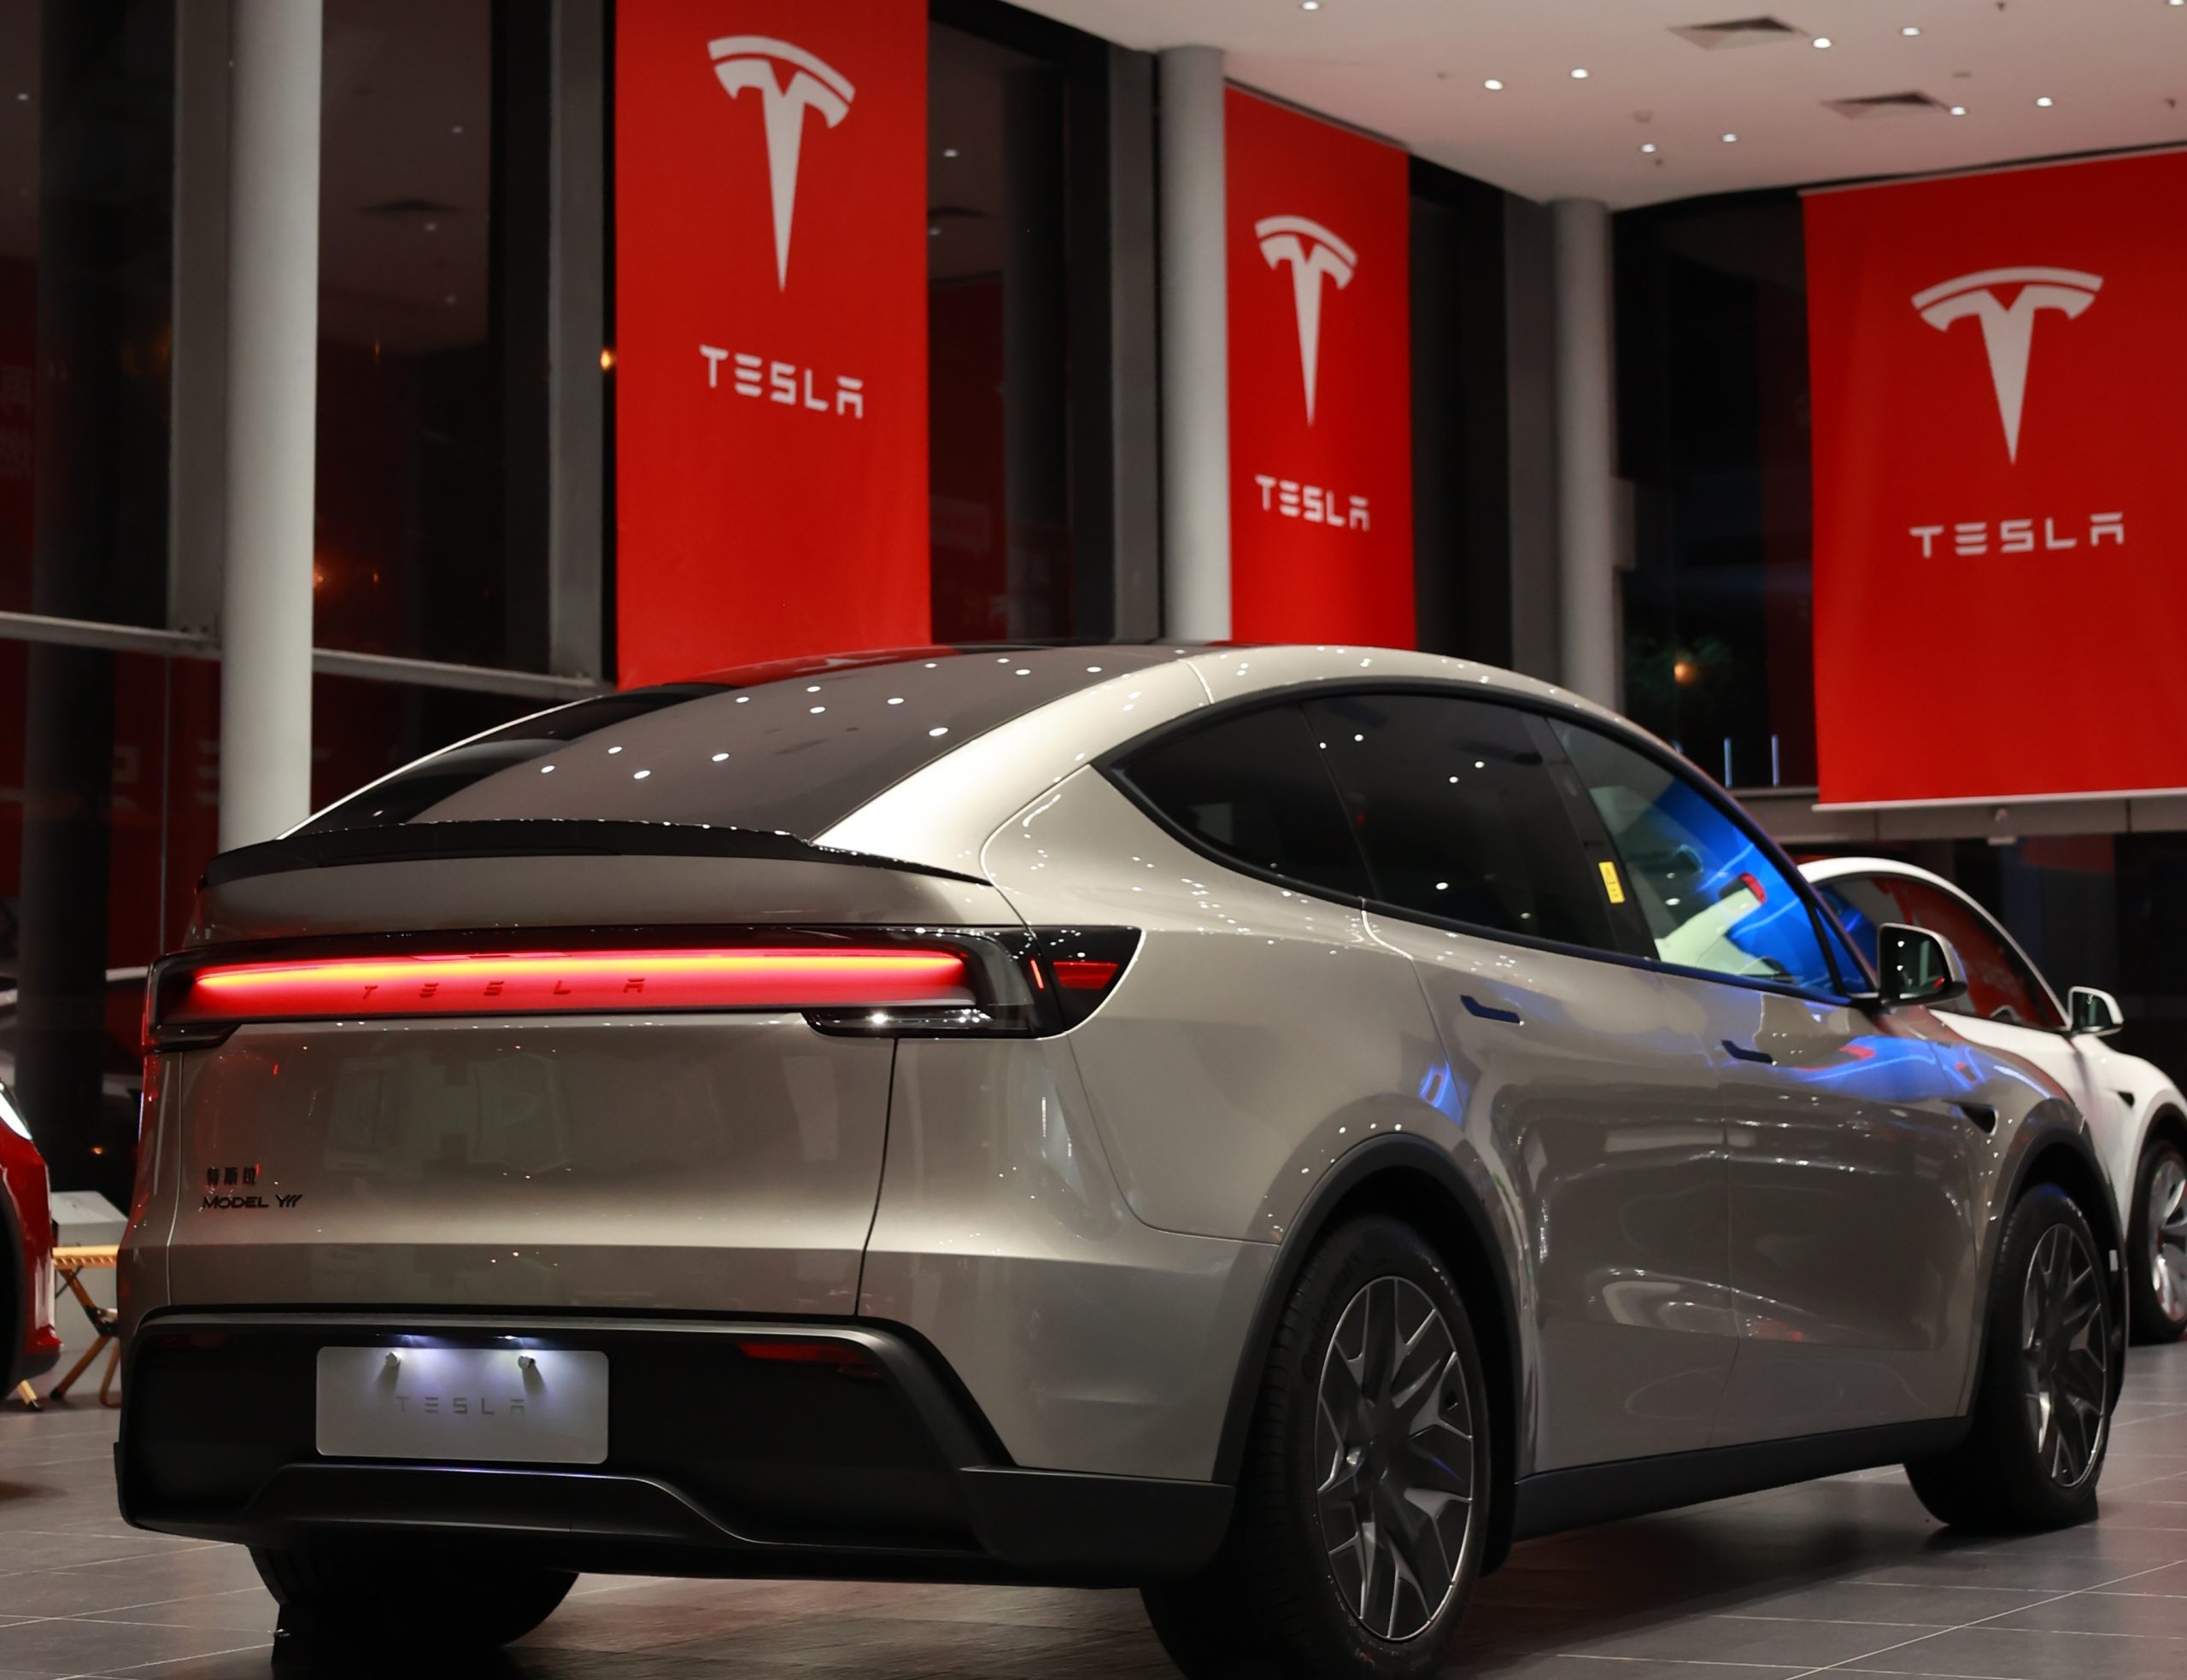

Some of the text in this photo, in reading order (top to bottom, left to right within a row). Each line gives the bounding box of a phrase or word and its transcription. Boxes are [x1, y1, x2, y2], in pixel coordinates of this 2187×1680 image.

[700, 344, 863, 419] TESLA
[1255, 474, 1369, 531] TESLA
[1909, 512, 2124, 559] TESLA
[363, 978, 645, 999] TESLA
[202, 1195, 269, 1209] MODEL
[396, 1396, 525, 1415] TESLA
